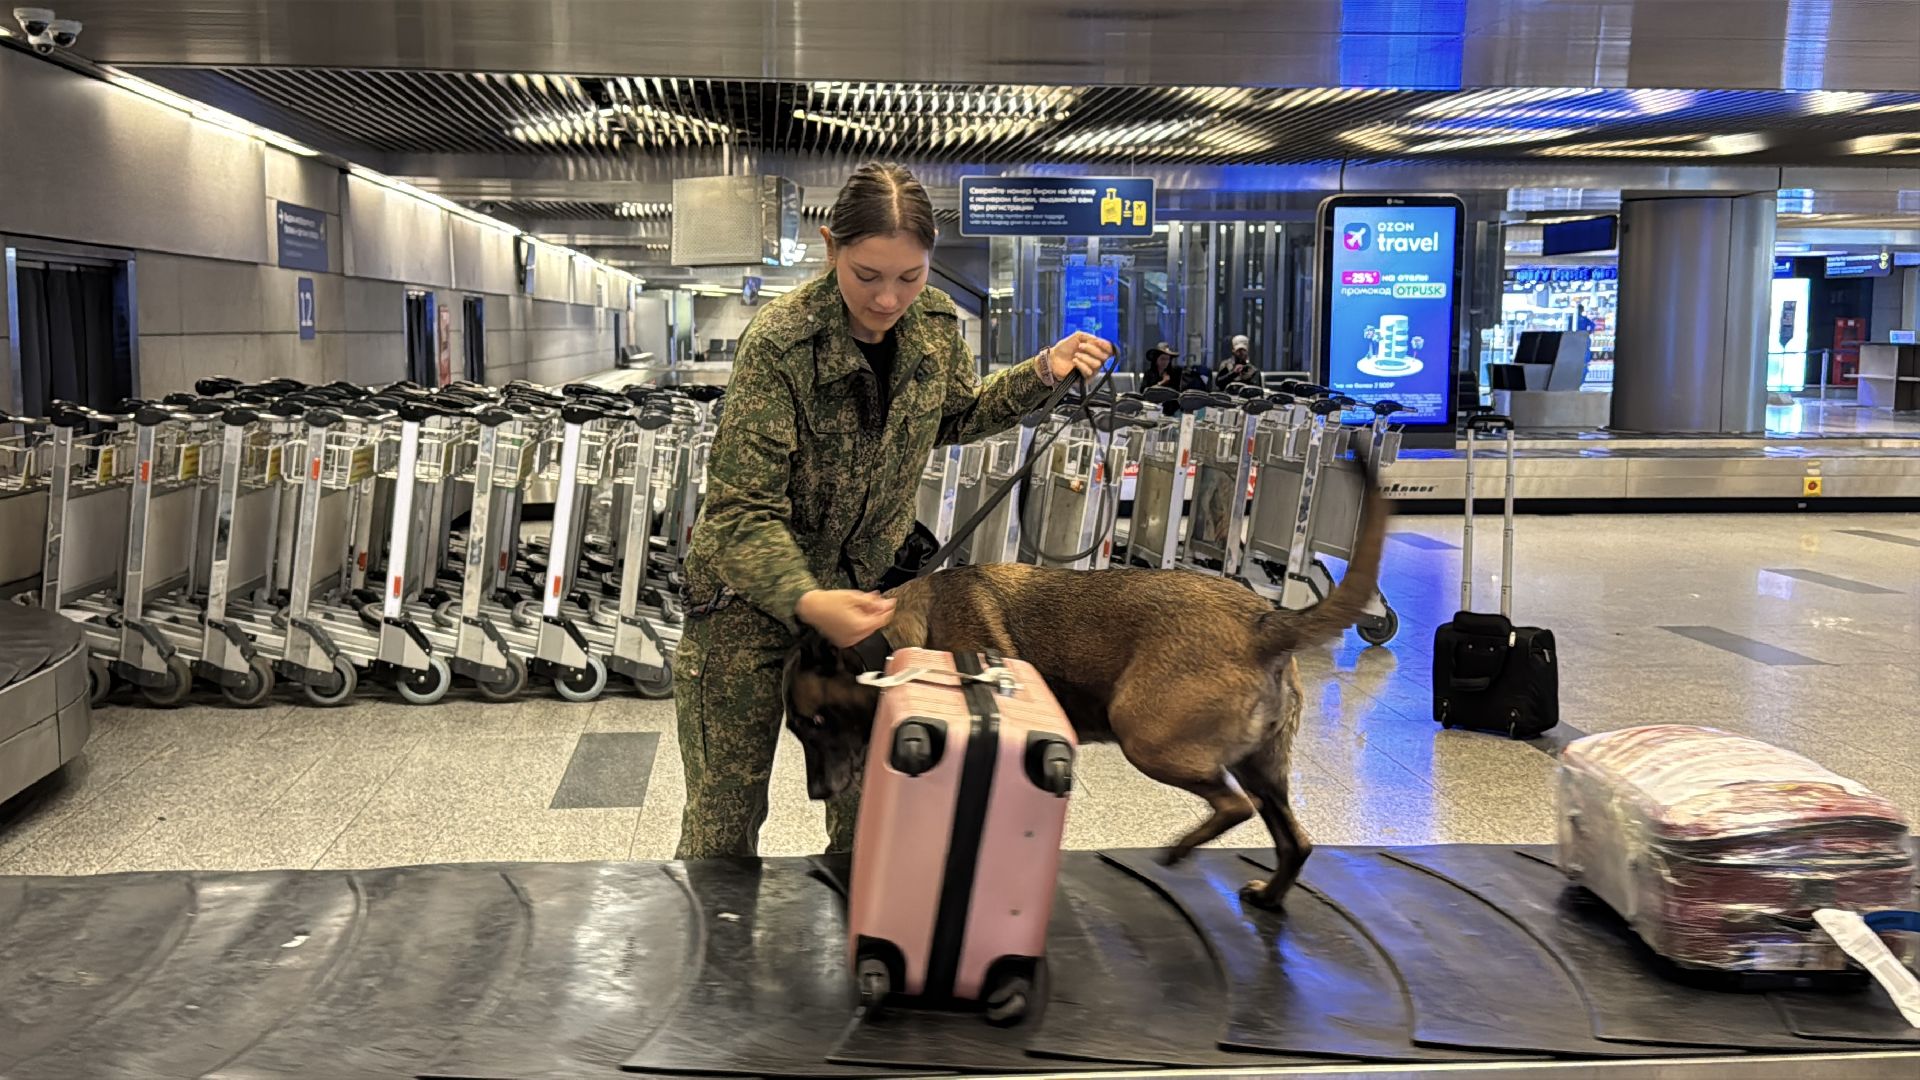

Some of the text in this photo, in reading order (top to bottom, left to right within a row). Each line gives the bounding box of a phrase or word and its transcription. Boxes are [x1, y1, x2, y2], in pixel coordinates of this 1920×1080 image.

[1007, 188, 1032, 196] номер
[1033, 187, 1056, 196] бирки
[1068, 187, 1097, 196] багаже
[969, 204, 1034, 212] при регистрации
[1377, 222, 1415, 232] OZON
[1377, 231, 1439, 252] travel
[1381, 274, 1396, 282] на
[1397, 274, 1429, 282] отели
[1341, 286, 1442, 297] промокод OTPUSK
[300, 291, 313, 326] 12
